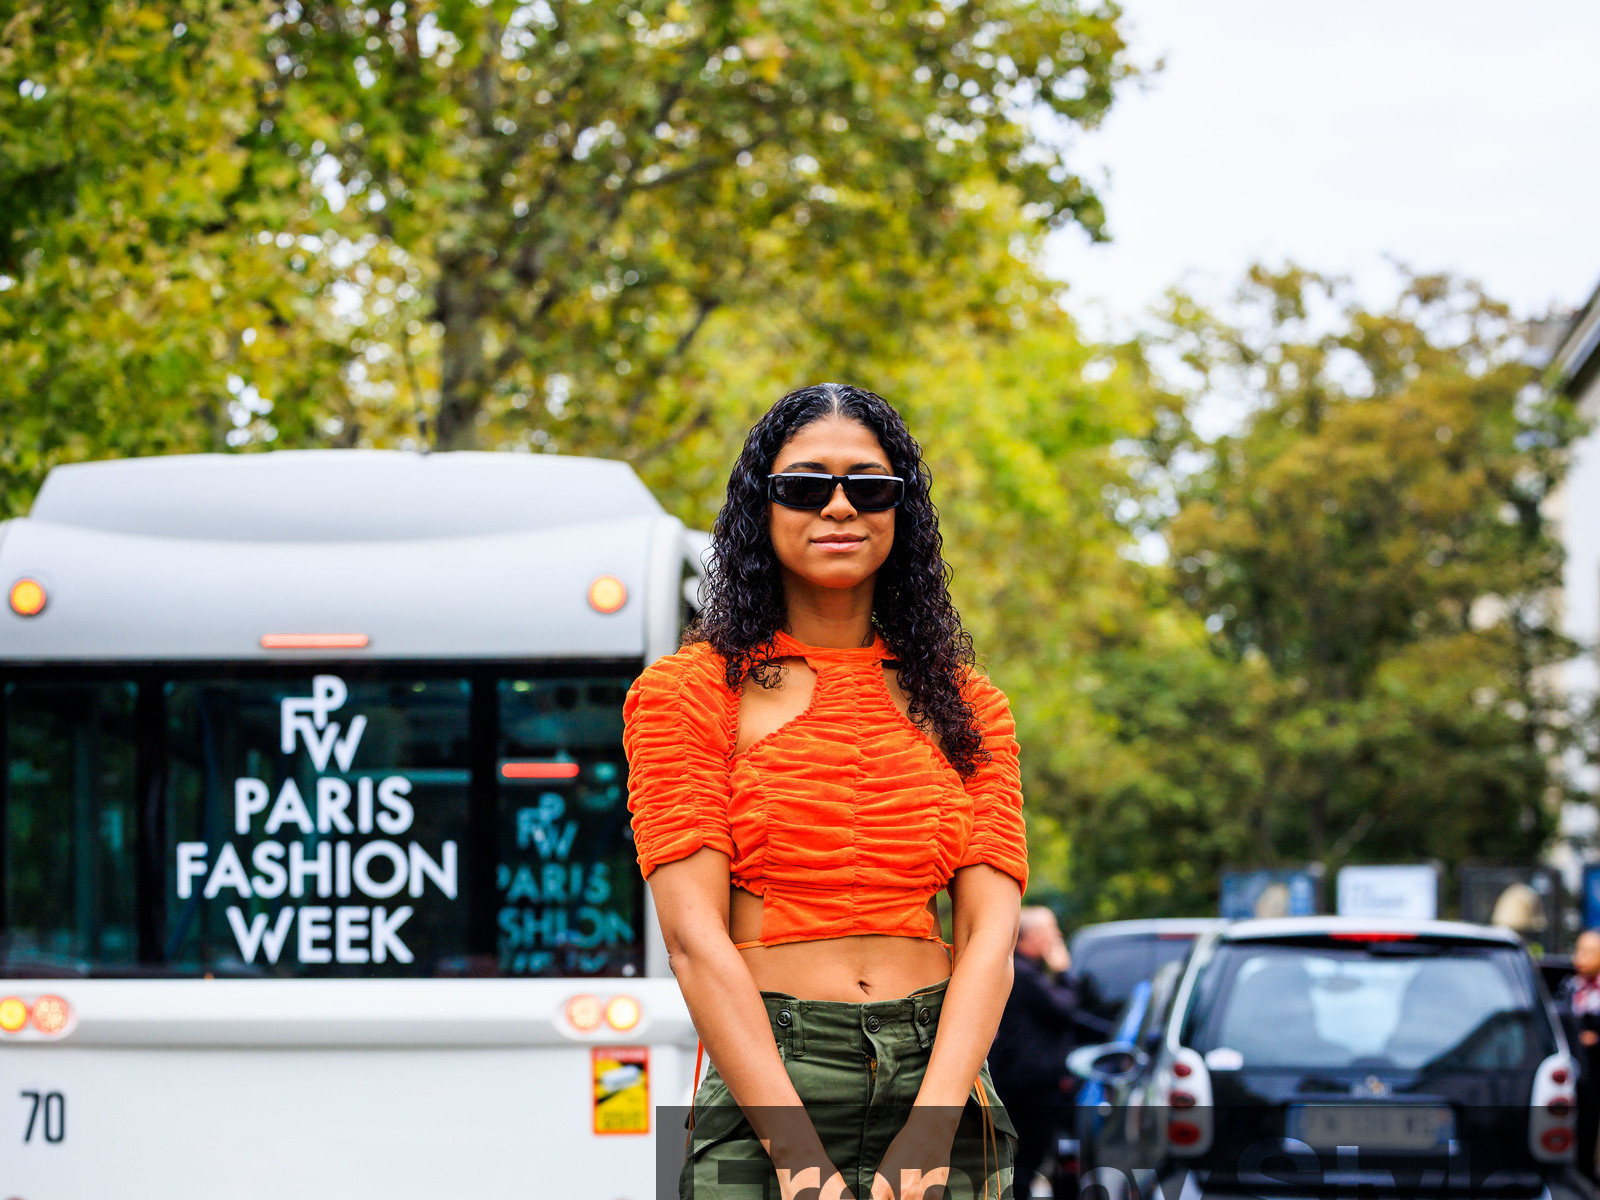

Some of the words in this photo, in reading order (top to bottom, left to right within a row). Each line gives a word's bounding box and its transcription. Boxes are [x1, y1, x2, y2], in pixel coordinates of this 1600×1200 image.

[235, 775, 415, 835] PARIS
[176, 839, 458, 900] FASHION
[225, 905, 415, 965] WEEK
[20, 1090, 65, 1144] 70
